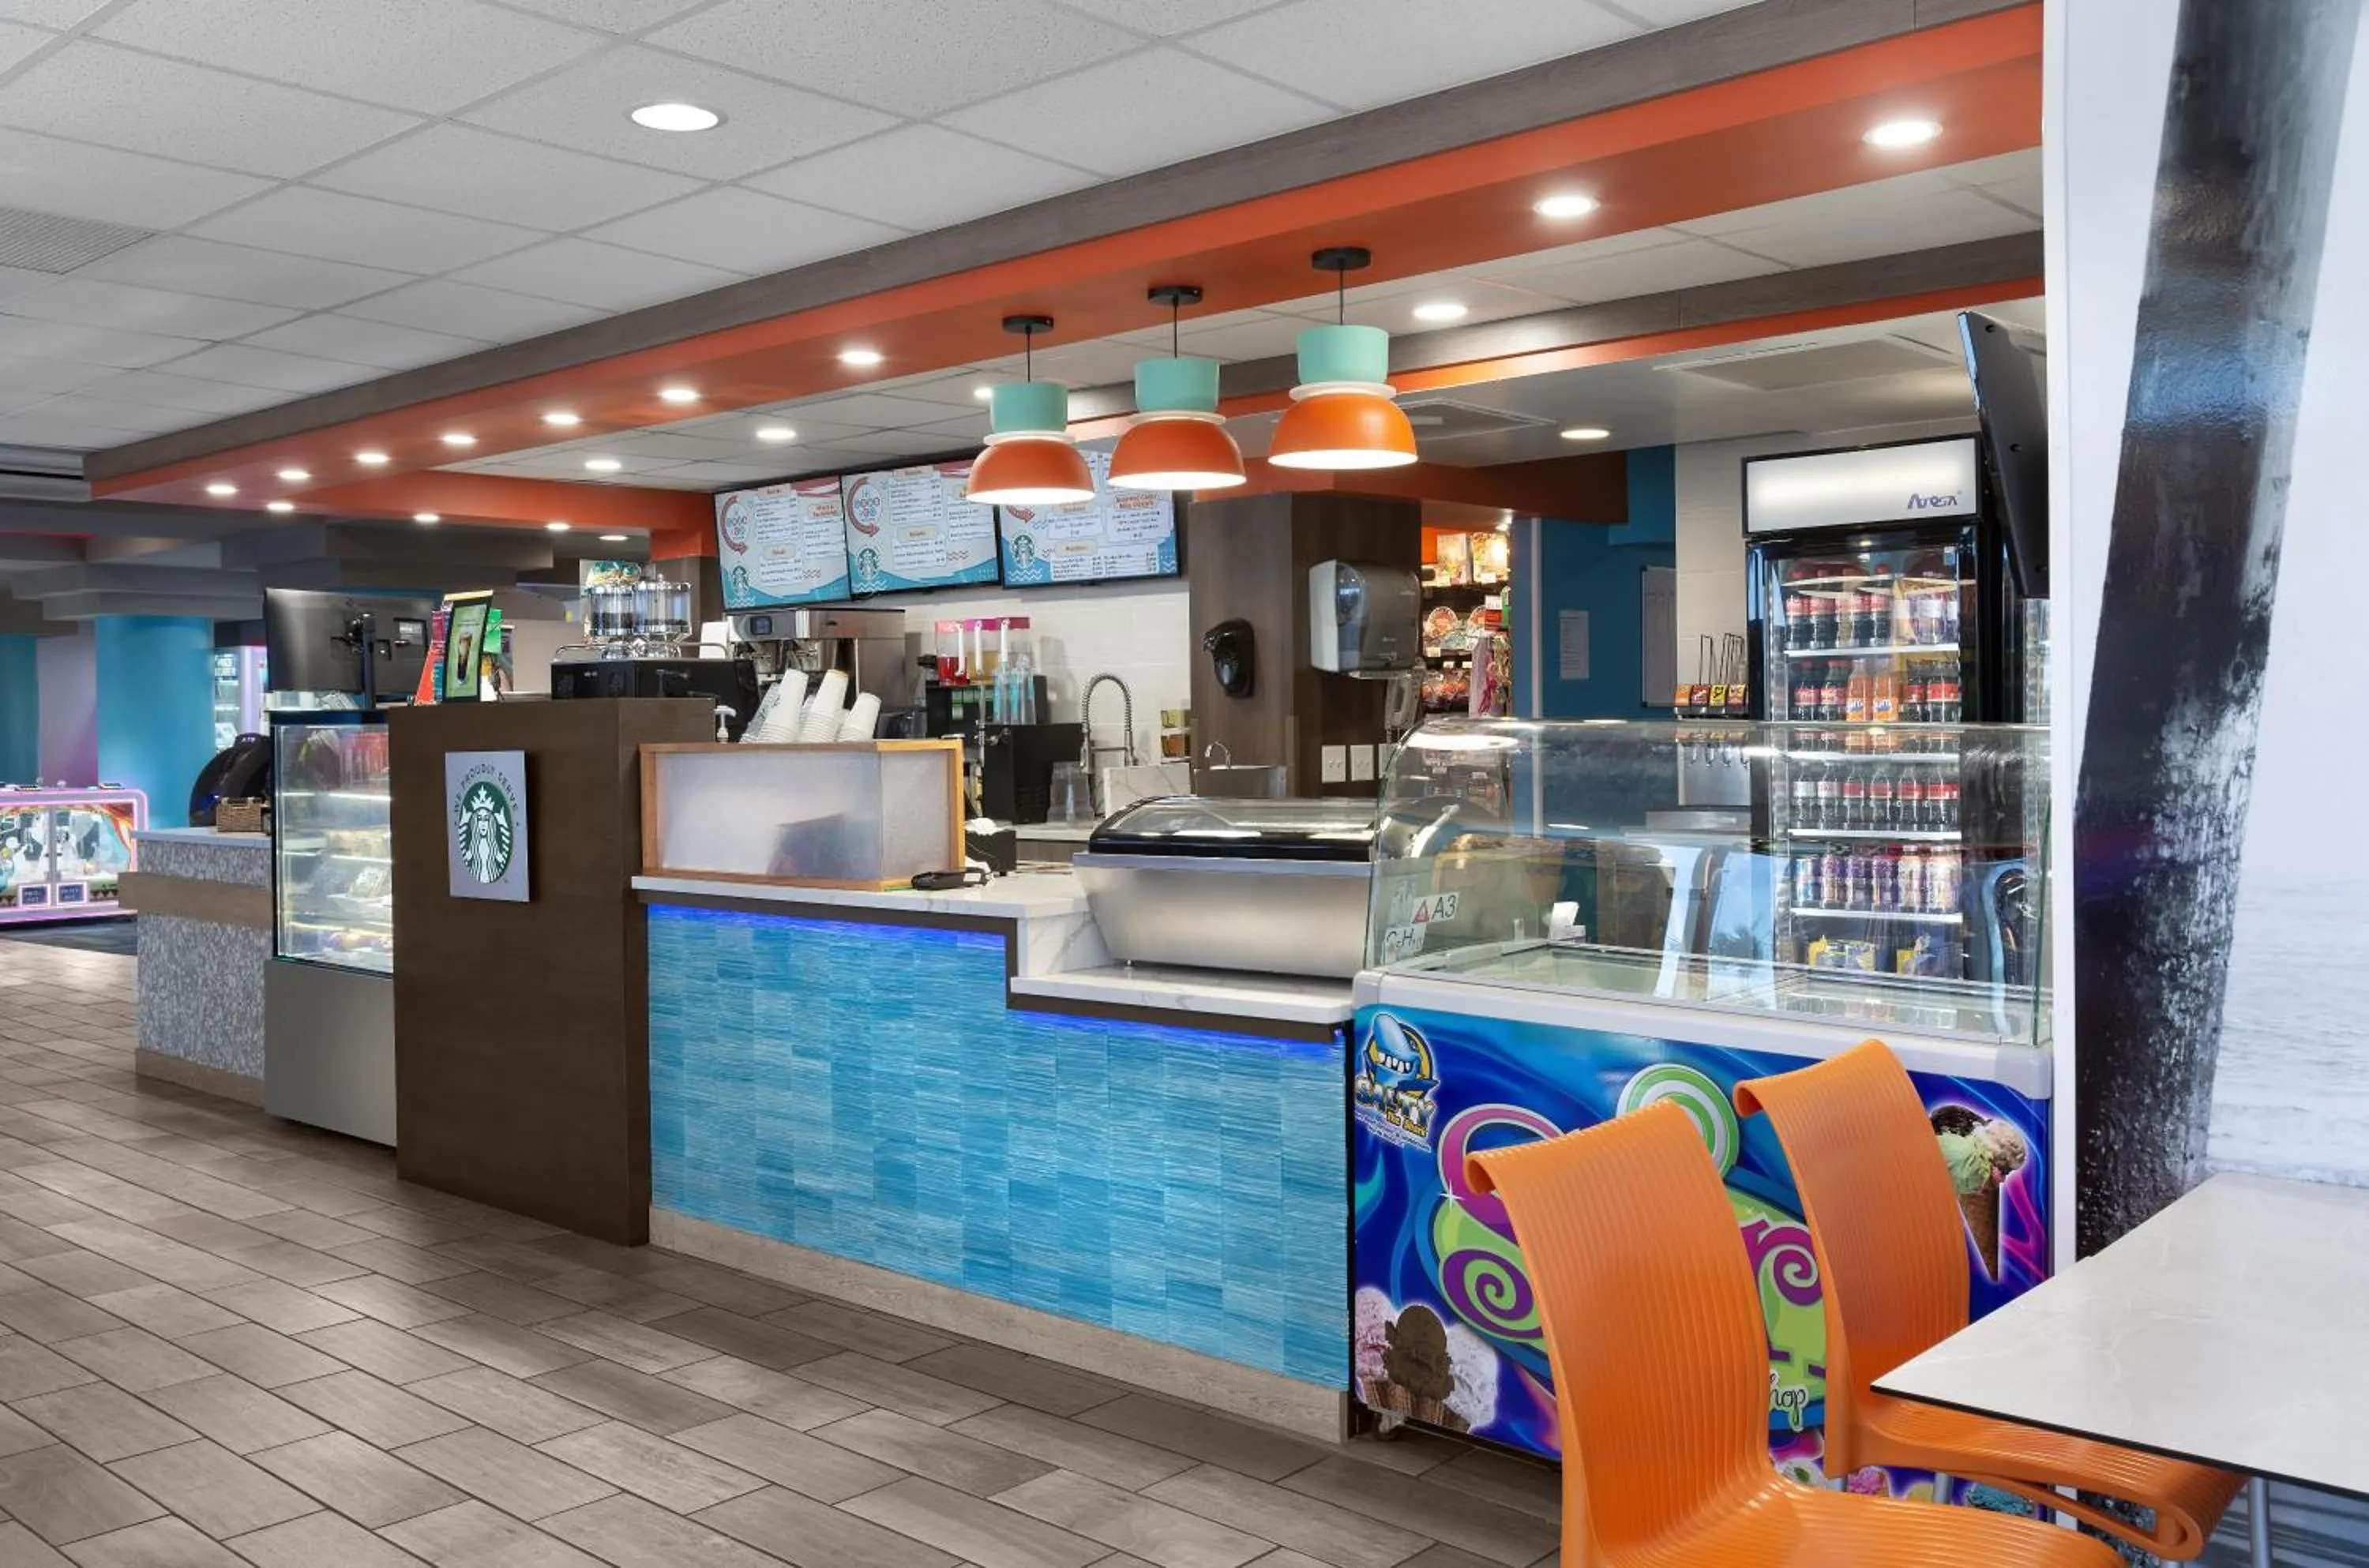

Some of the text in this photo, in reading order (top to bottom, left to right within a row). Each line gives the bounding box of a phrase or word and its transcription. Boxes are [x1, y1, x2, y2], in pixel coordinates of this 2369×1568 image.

[461, 763, 495, 790] PROUDLY
[1432, 895, 1457, 920] A3
[1355, 1075, 1436, 1125] SALTY
[1387, 1108, 1402, 1127] The
[1402, 1113, 1427, 1138] Shark
[1768, 1372, 1806, 1426] hop
